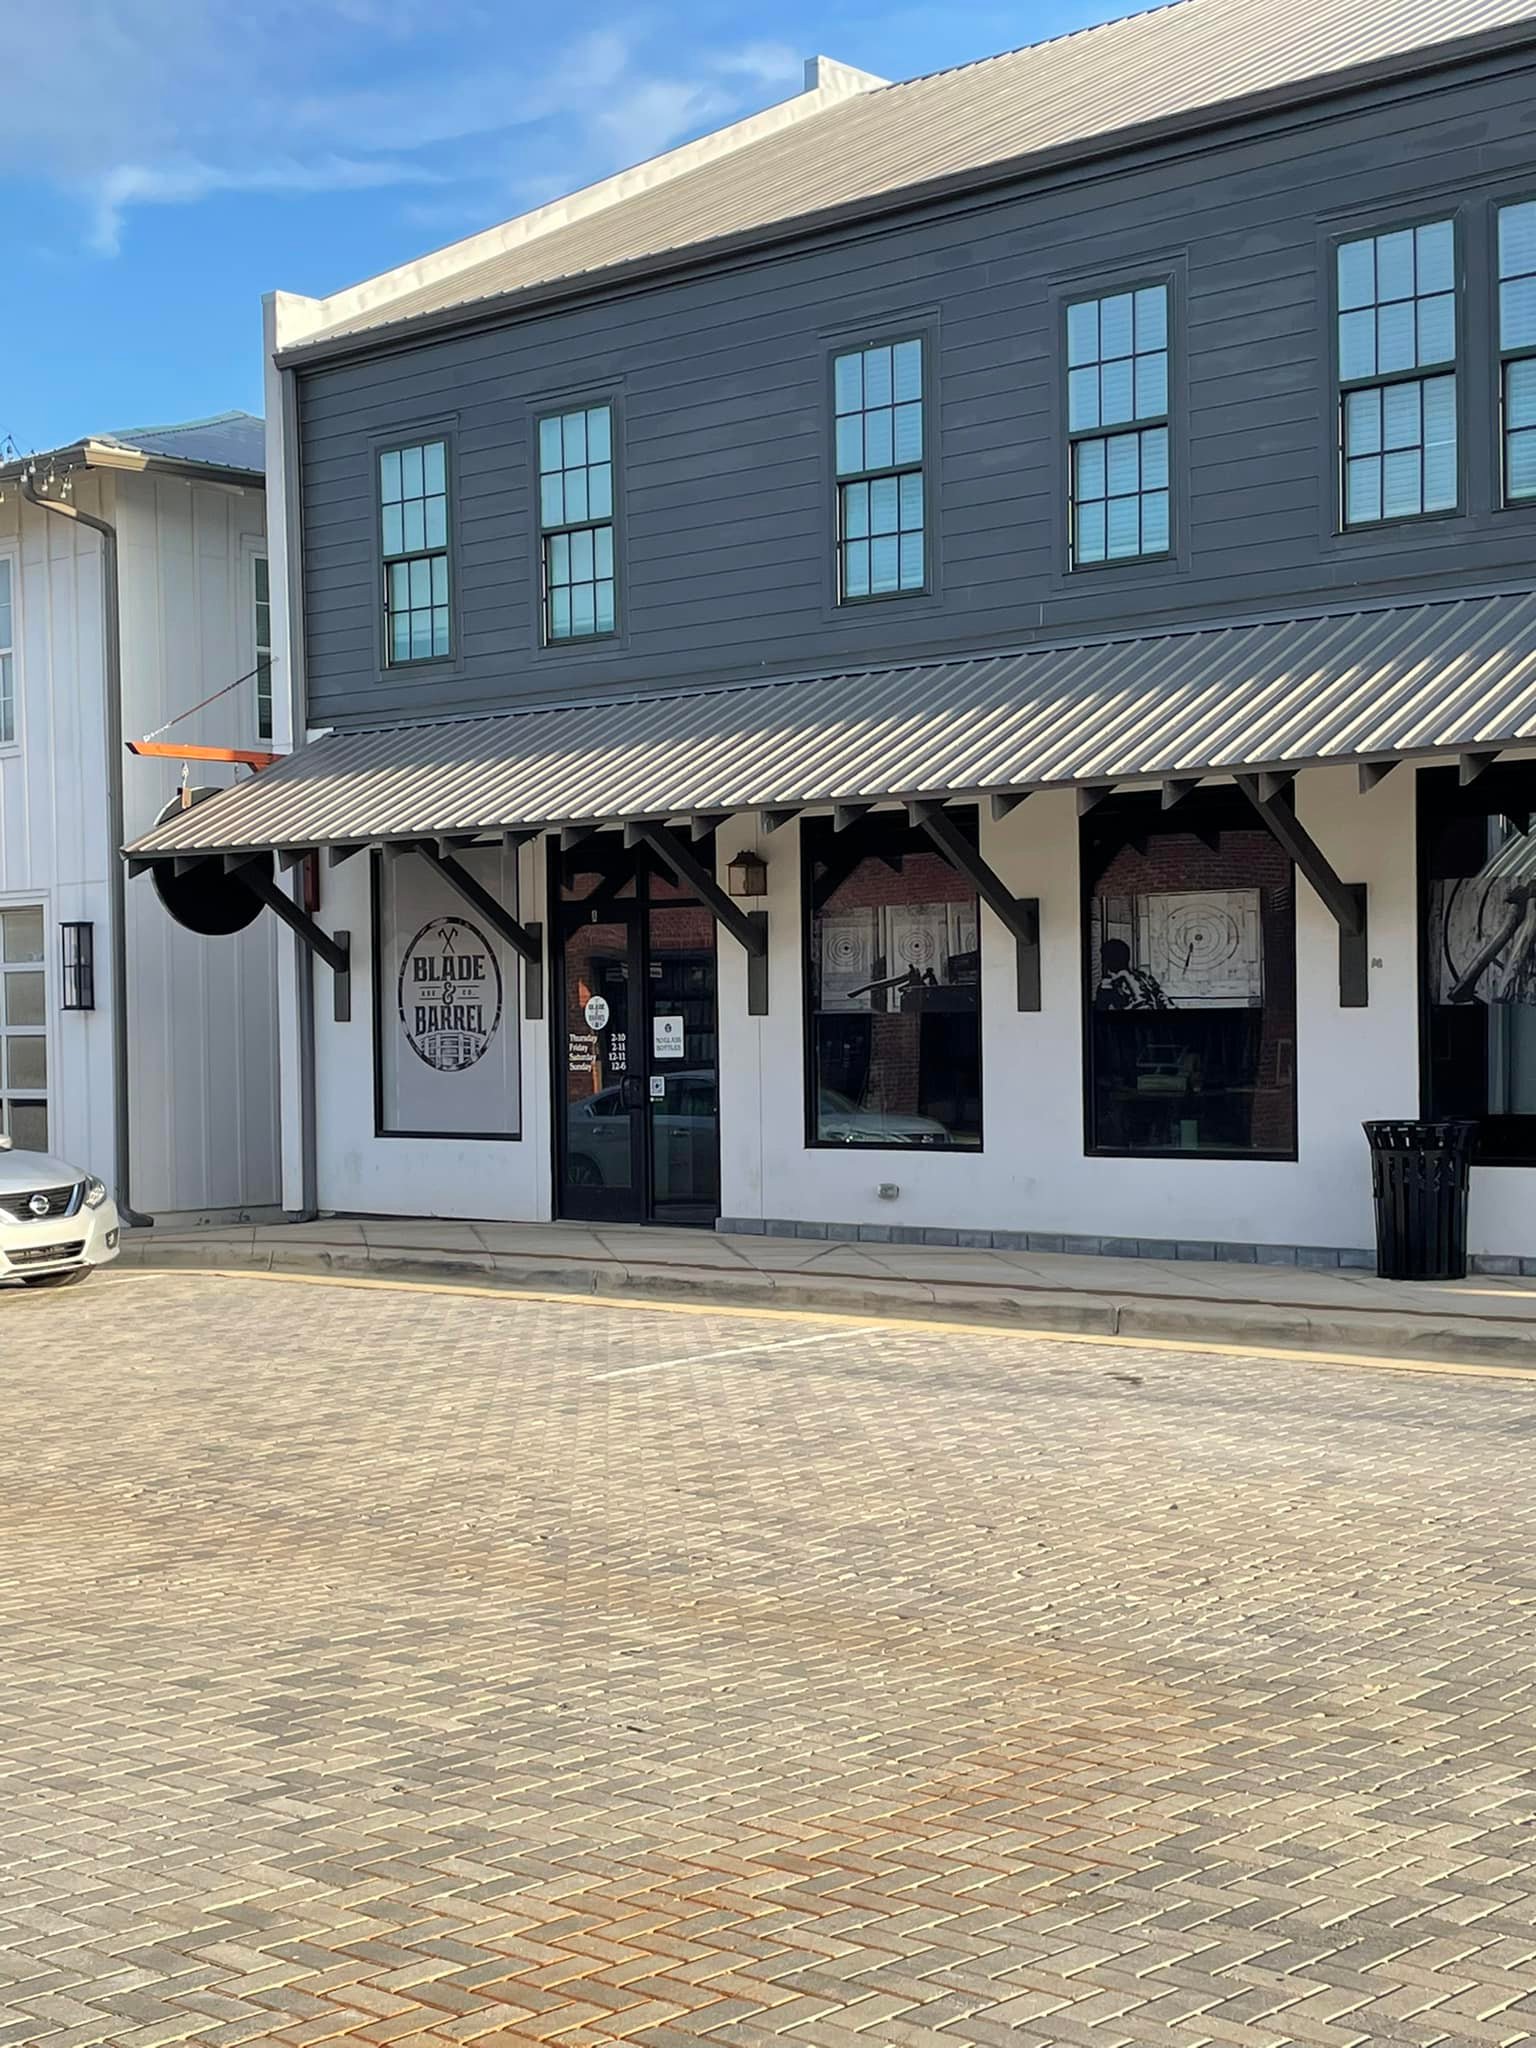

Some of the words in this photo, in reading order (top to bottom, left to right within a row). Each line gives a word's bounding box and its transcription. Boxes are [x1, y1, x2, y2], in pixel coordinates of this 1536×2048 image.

[413, 954, 486, 982] BLADE
[442, 981, 456, 1005] &
[414, 1005, 487, 1037] BARREL
[569, 1034, 598, 1044] Thursday
[611, 1033, 626, 1042] 2-10
[569, 1043, 589, 1053] Friday
[611, 1043, 626, 1051] 2-11
[569, 1052, 596, 1062] Saturday
[608, 1052, 626, 1061] 12-11
[569, 1062, 592, 1072] Sunday
[611, 1061, 627, 1070] 12-6
